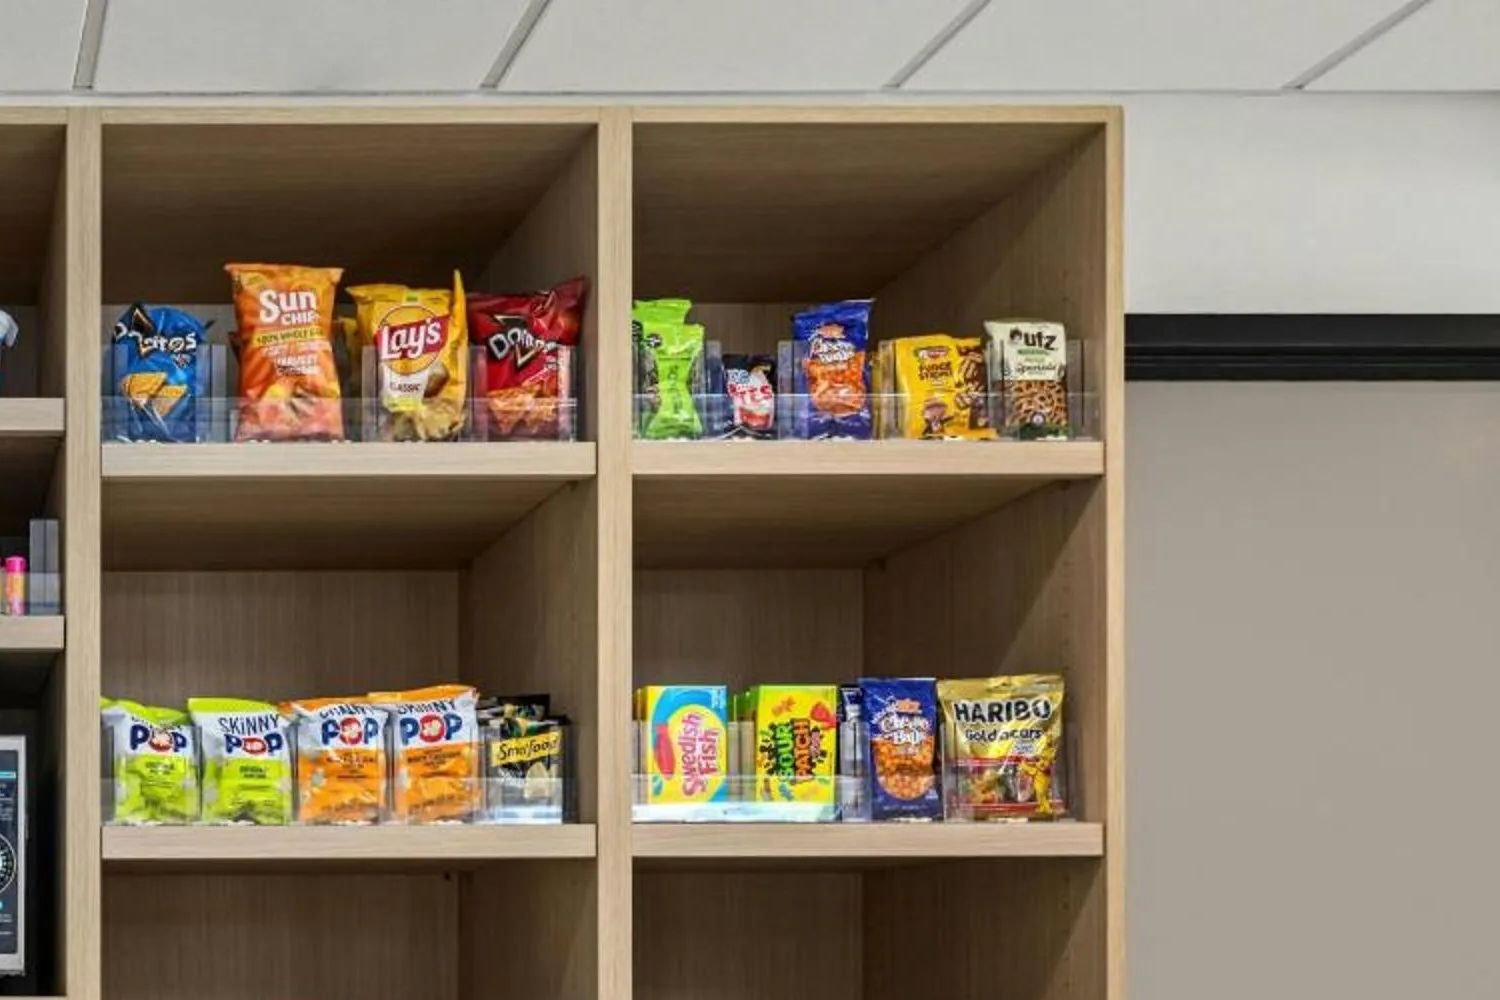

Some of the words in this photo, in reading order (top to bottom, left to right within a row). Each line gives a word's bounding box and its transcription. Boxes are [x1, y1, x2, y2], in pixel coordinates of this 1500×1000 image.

[259, 289, 317, 323] Sun
[380, 318, 441, 360] Lay's
[1023, 331, 1058, 351] utz
[953, 699, 1052, 723] HARIBO
[224, 733, 283, 754] POP
[321, 717, 379, 746] POP
[399, 713, 463, 746] POP
[499, 739, 558, 761] Smafood
[678, 711, 707, 797] Swedish
[698, 728, 719, 776] Fish
[794, 719, 811, 781] PATCH
